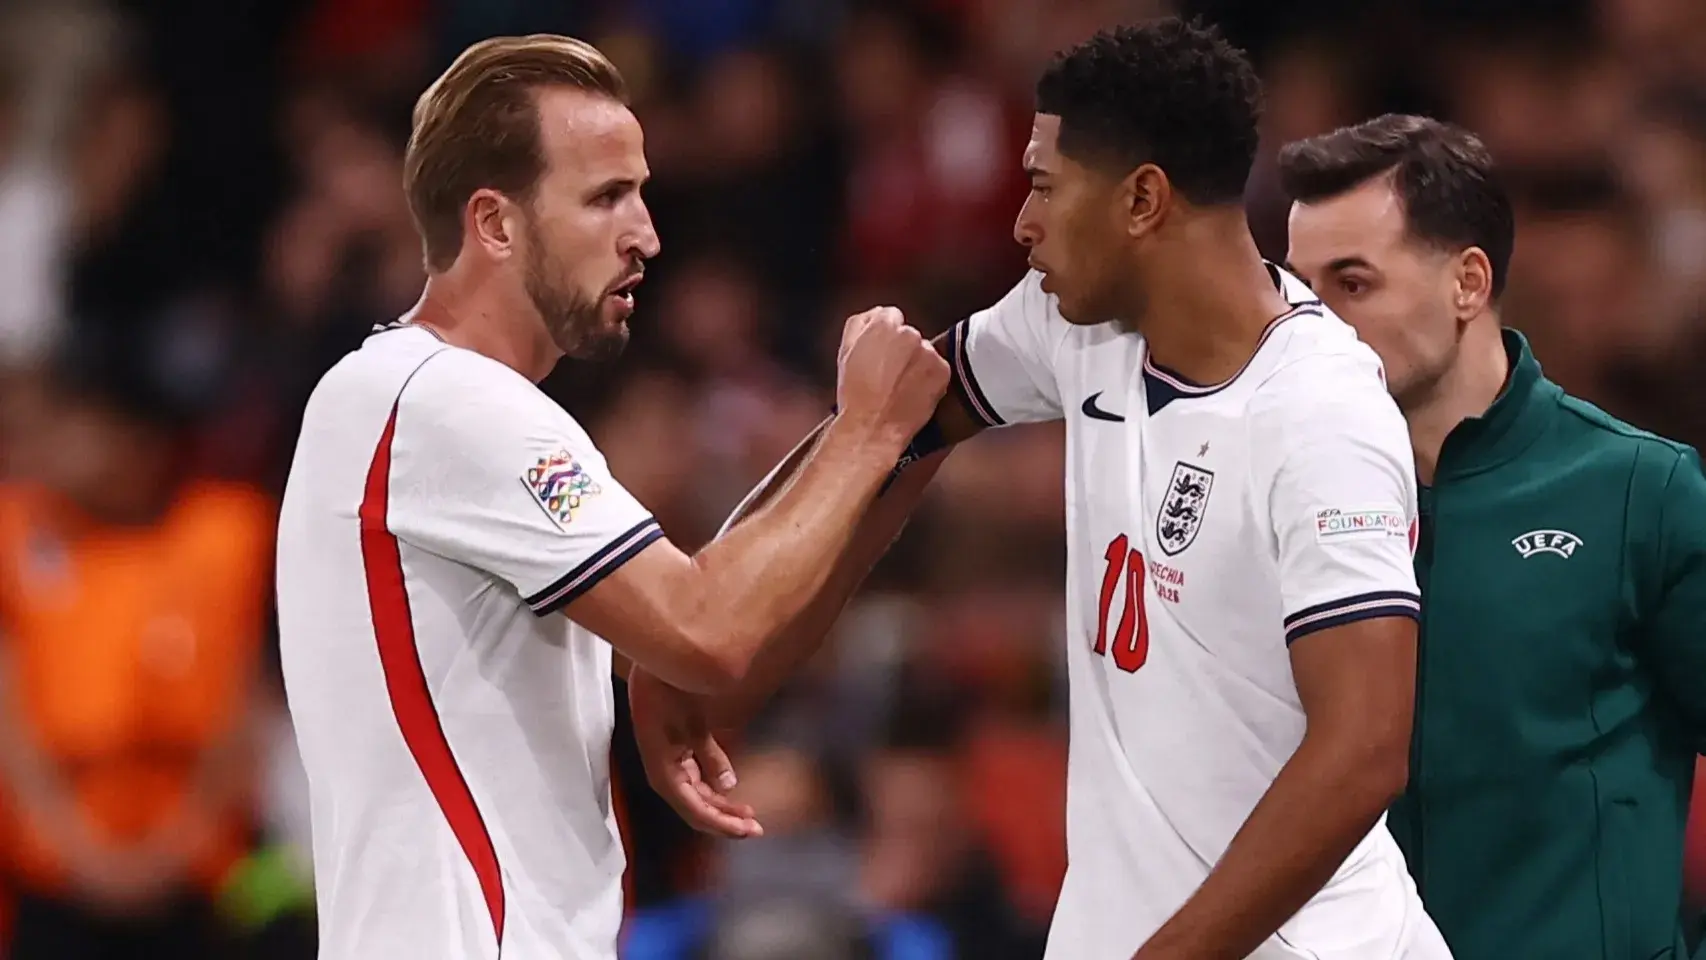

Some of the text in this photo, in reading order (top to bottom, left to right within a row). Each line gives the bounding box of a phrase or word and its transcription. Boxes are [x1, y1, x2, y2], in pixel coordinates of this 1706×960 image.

[1317, 509, 1341, 518] UEFA
[1515, 534, 1576, 556] UEFA
[1094, 532, 1149, 674] 10
